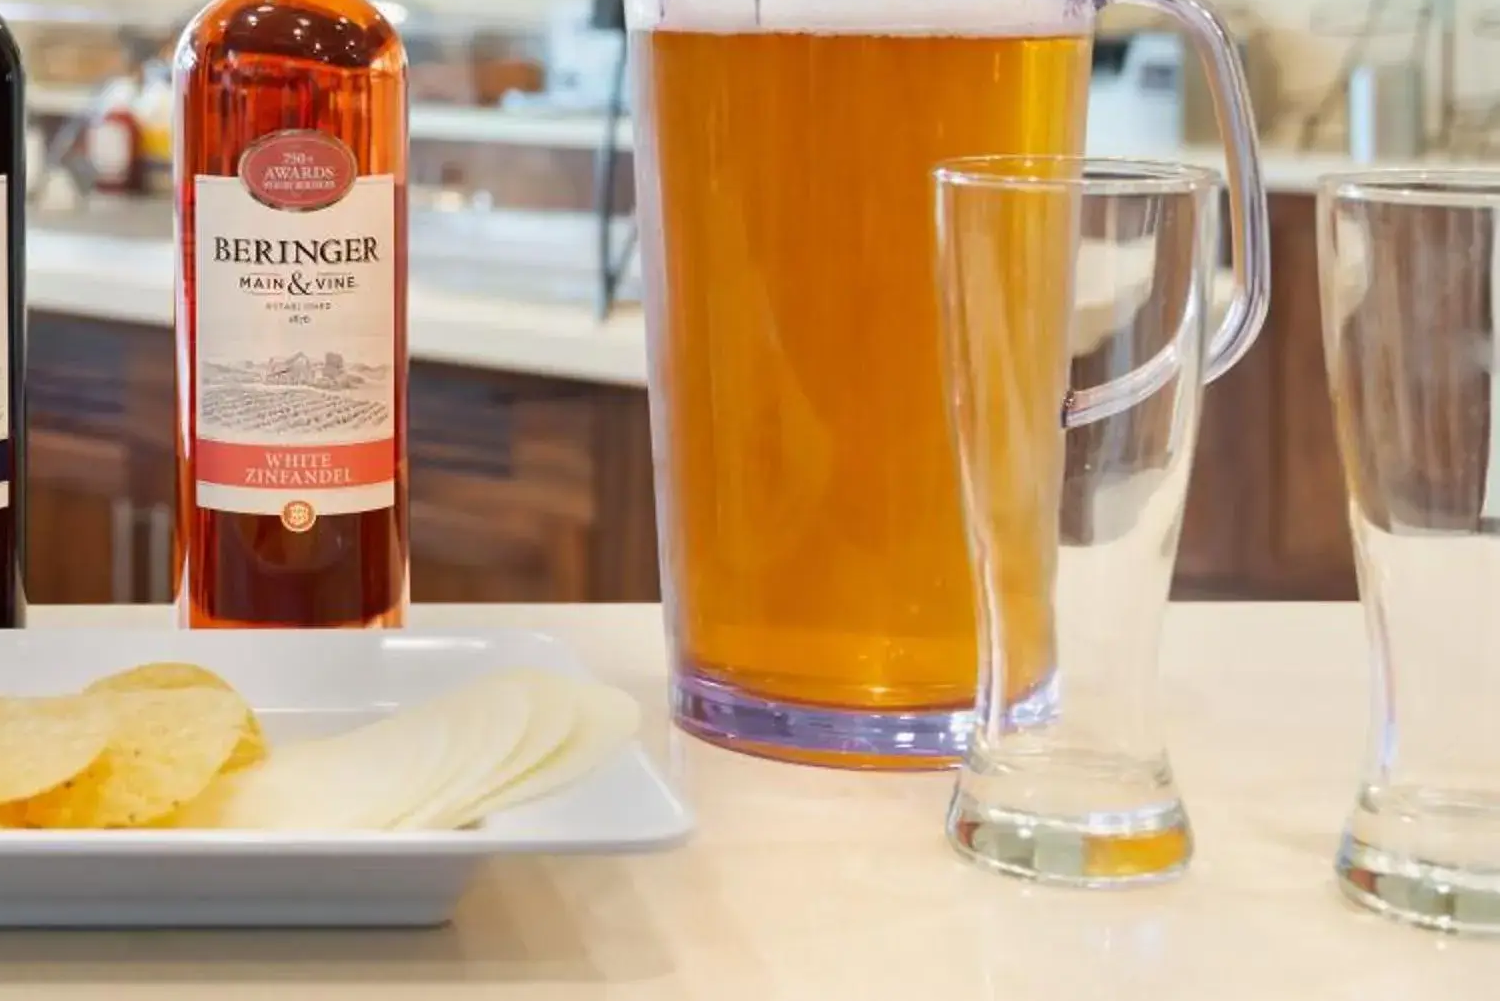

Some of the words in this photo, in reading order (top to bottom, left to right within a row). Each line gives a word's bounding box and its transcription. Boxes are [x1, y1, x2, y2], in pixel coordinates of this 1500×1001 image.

[264, 166, 336, 180] AWARDS
[214, 236, 380, 265] BERINGER
[239, 276, 285, 290] MAIN
[287, 270, 313, 296] &
[315, 275, 356, 289] VINE
[264, 452, 333, 469] WHITE
[244, 468, 353, 485] ZINFANDEL
